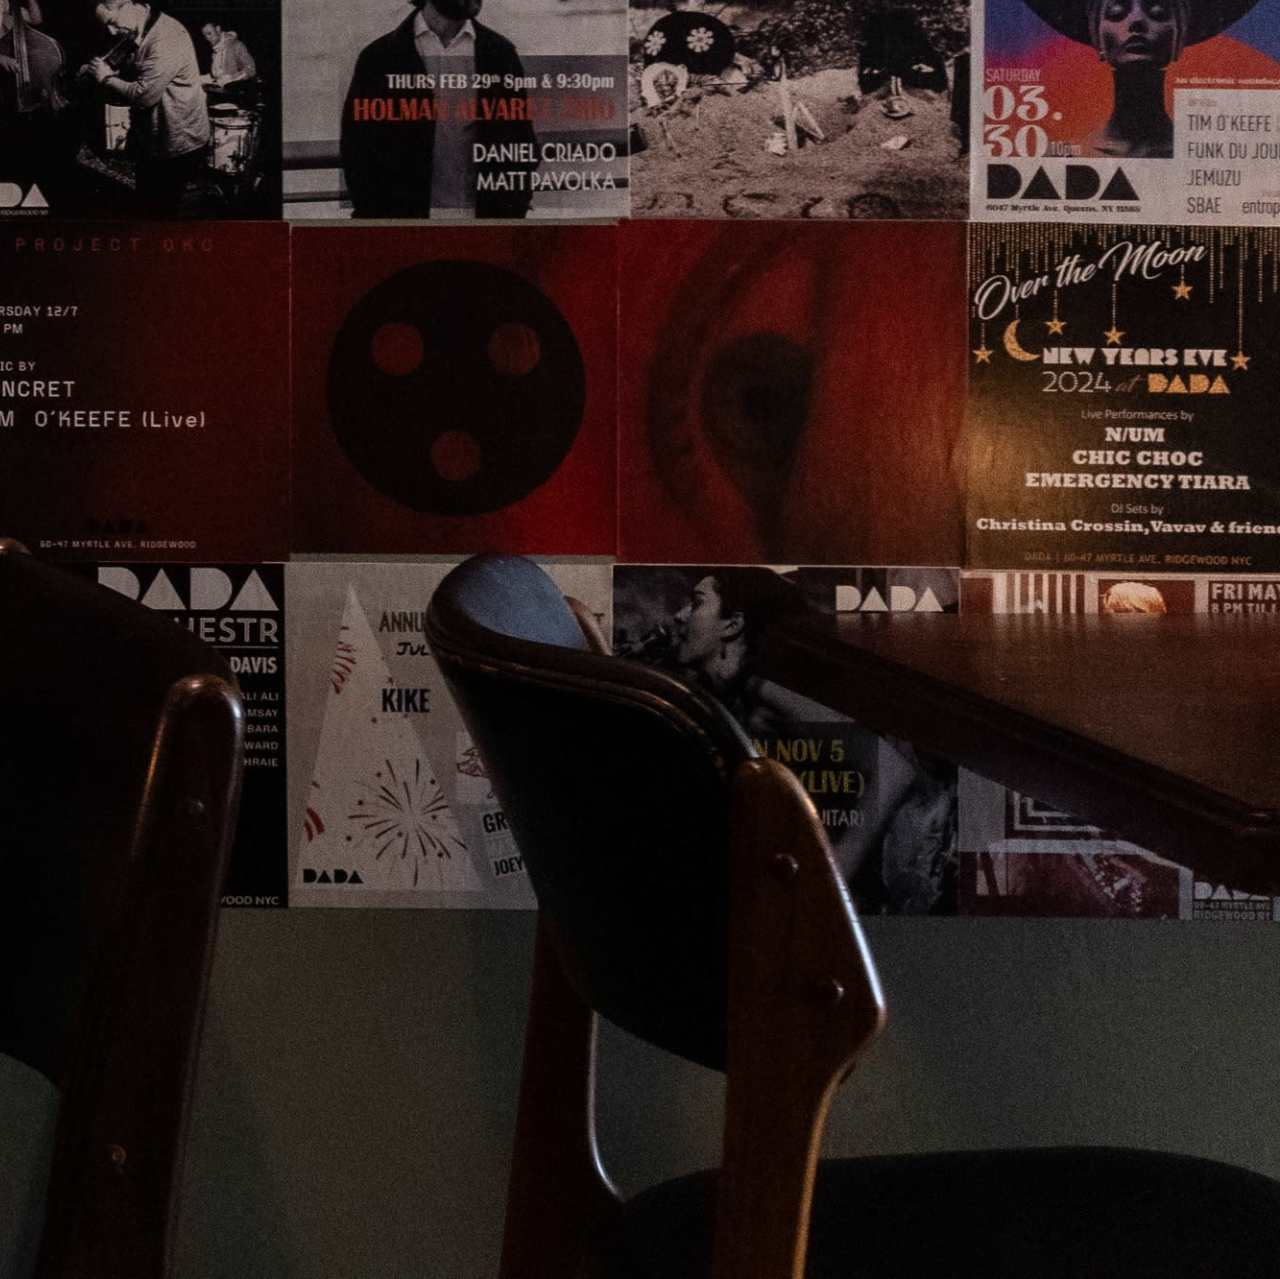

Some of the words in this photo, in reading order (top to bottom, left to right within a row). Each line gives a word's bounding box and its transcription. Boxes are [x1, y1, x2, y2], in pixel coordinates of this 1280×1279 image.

[473, 143, 538, 163] DANIEL
[541, 142, 617, 163] CRIADO
[987, 163, 1139, 201] DADA
[975, 273, 1047, 321] Over
[1055, 248, 1097, 287] the
[1098, 237, 1208, 279] Moon
[34, 411, 131, 429] O'KEEFE
[142, 411, 206, 429] (Live)
[1025, 473, 1175, 490] EMERGENCY
[1178, 474, 1250, 491] TIARA
